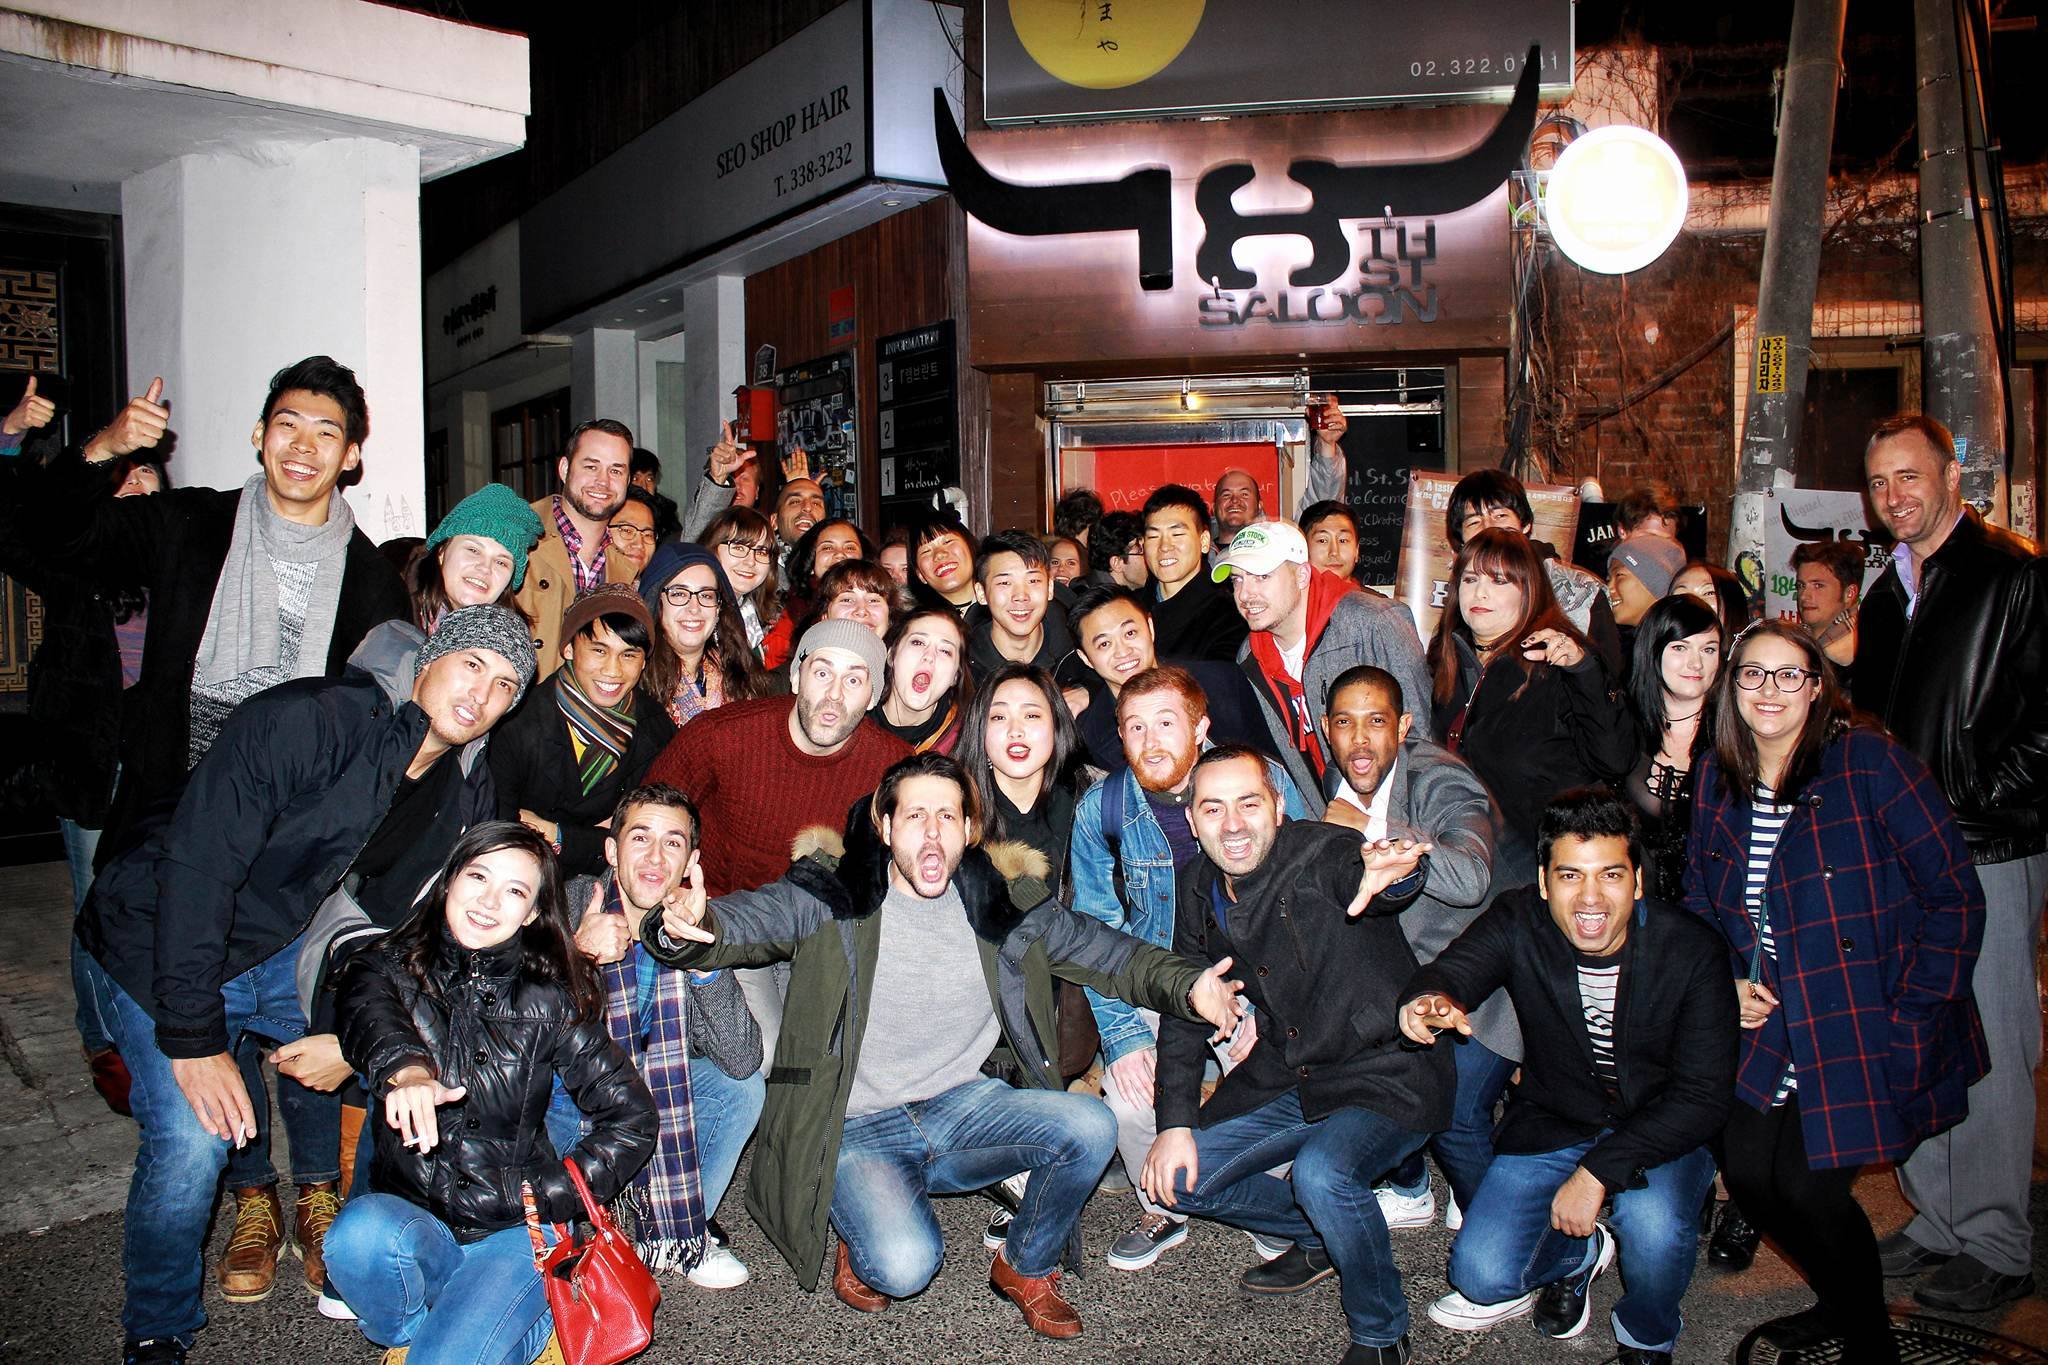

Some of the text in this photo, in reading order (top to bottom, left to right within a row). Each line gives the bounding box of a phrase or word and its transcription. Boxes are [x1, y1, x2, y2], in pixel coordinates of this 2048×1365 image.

[716, 85, 851, 179] SEO SHOP HAIR
[774, 142, 852, 197] T. 338-3232
[1199, 285, 1438, 330] SALOON
[885, 330, 939, 356] INFORMATION
[884, 421, 891, 440] 2
[885, 468, 891, 488] 1
[1246, 530, 1266, 544] STOCK
